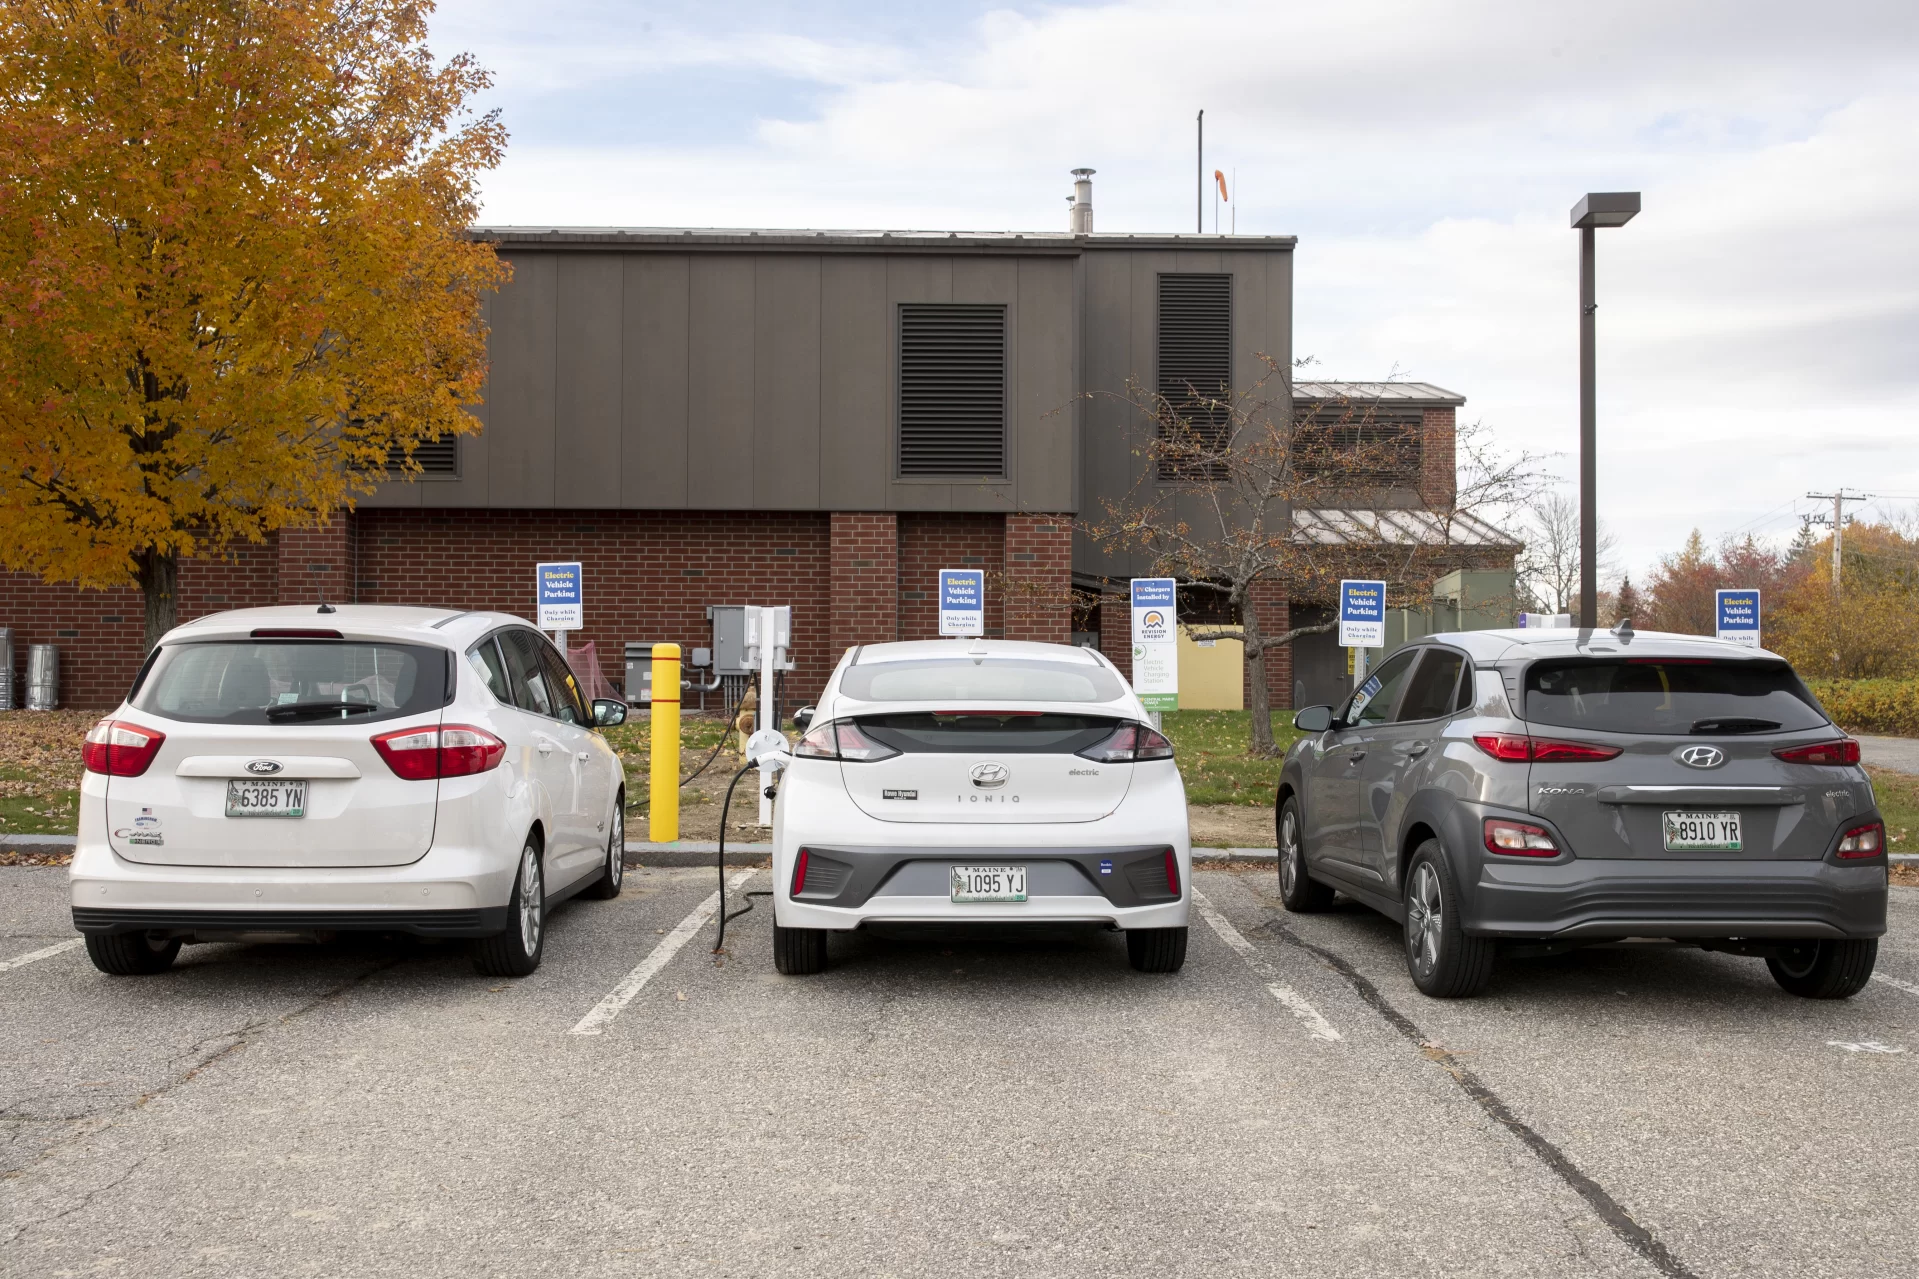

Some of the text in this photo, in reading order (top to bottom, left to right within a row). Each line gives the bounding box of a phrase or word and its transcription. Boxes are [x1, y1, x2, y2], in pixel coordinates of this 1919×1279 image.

[1348, 608, 1378, 616] Parking
[253, 762, 273, 771] Ford
[242, 788, 302, 807] 6385 YN
[1680, 822, 1738, 841] 8910 YR
[967, 874, 1023, 893] 1095 YJ
